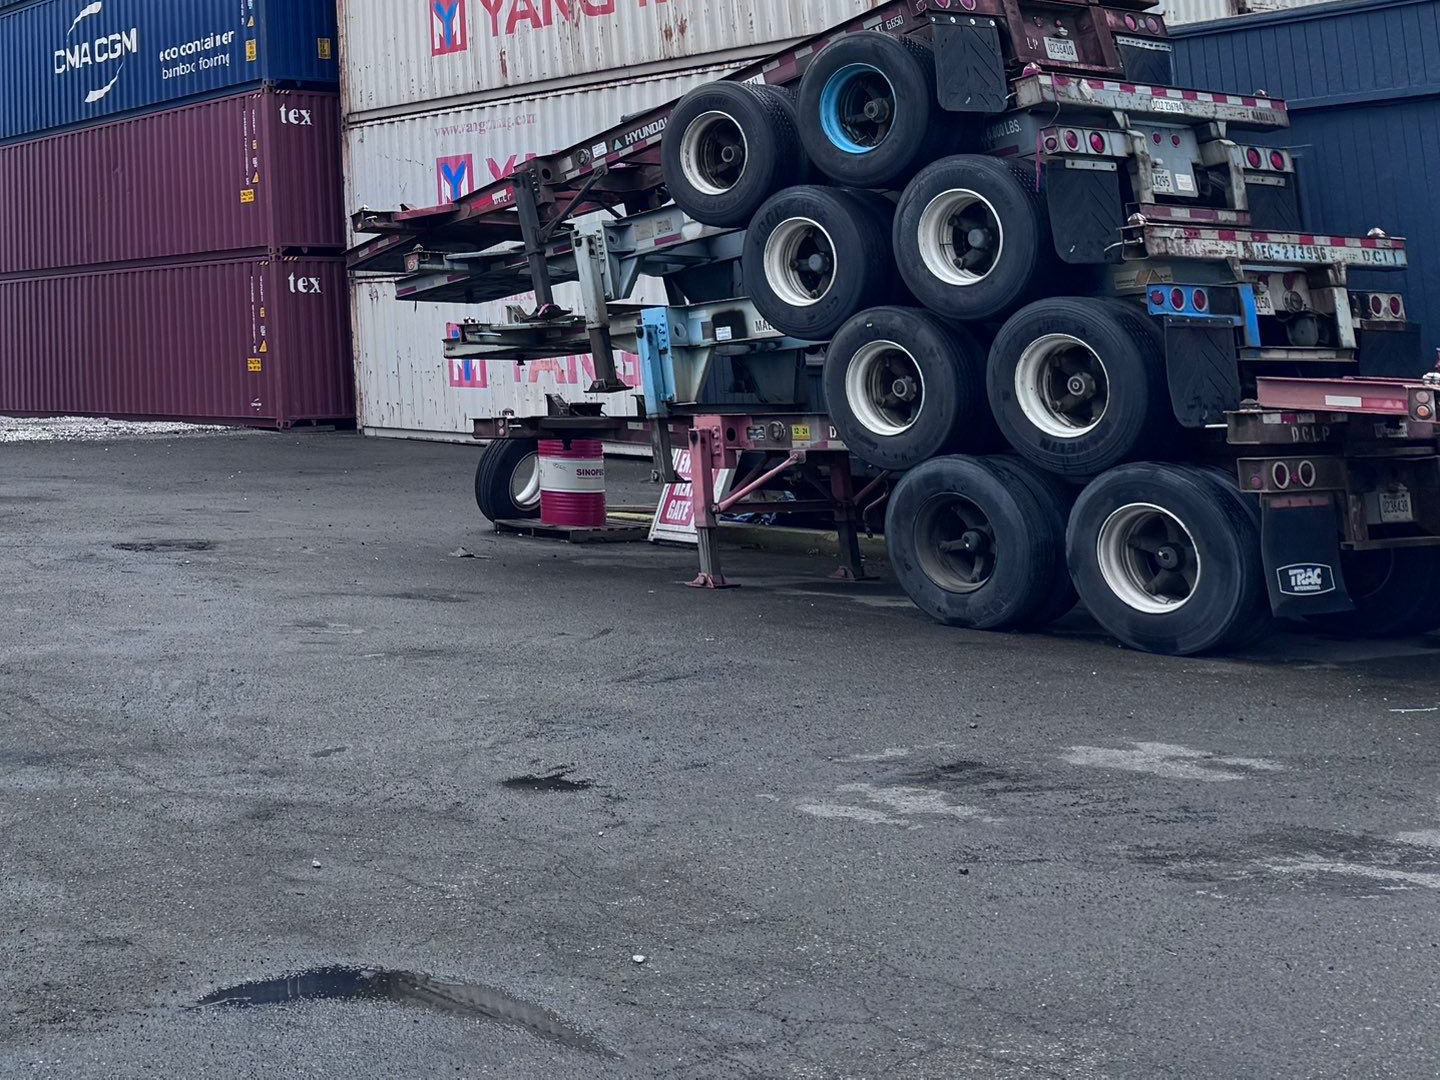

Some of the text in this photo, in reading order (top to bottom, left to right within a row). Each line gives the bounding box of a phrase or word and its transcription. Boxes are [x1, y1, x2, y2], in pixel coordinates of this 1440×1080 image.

[54, 28, 137, 74] CMA CGM
[279, 103, 312, 125] tex
[287, 272, 322, 293] tex
[576, 468, 605, 477] SINOPE
[666, 499, 692, 521] GATE
[1288, 567, 1322, 587] TRAC
